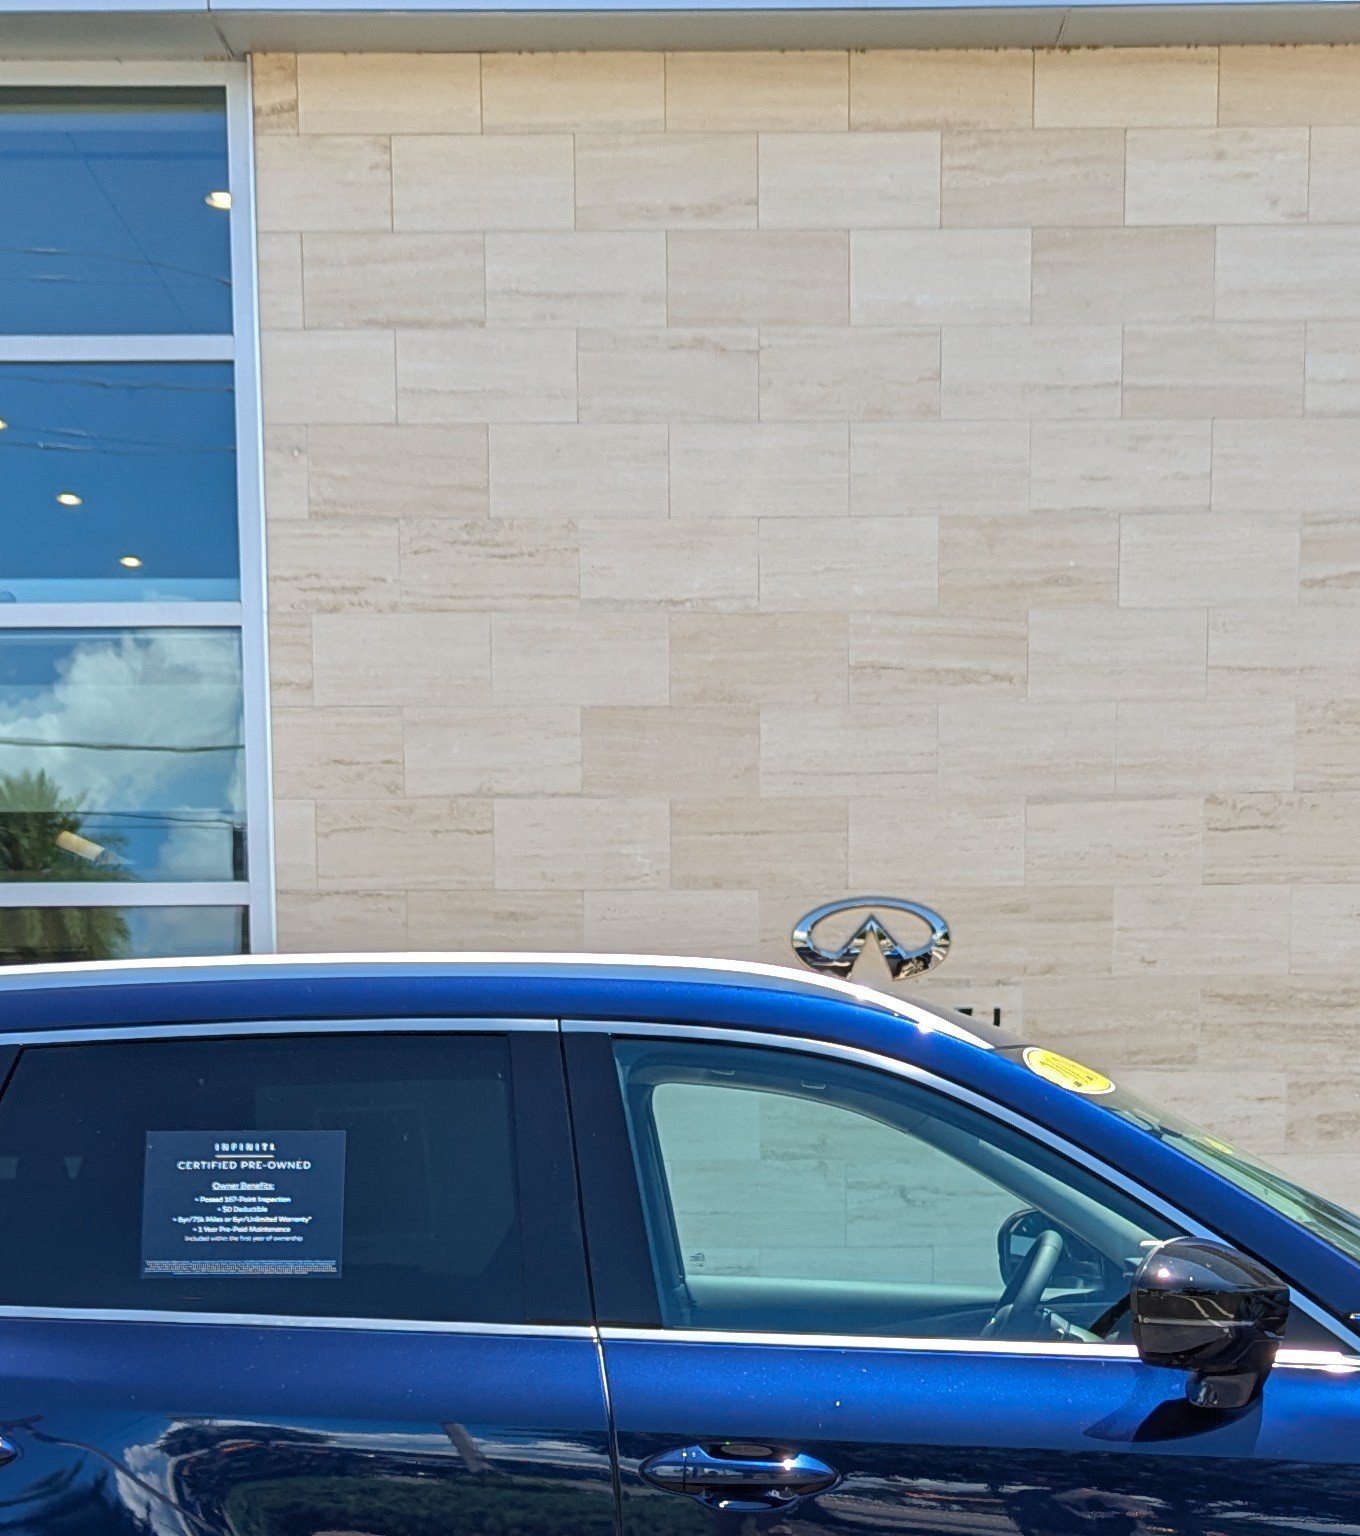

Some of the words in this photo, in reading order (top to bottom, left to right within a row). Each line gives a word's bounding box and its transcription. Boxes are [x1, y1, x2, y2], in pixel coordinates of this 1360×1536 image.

[214, 1142, 276, 1151] INFINITI
[176, 1160, 238, 1170] CERTIFIED
[240, 1160, 312, 1170] PRE-OWNED
[211, 1181, 239, 1191] Owner
[258, 1195, 291, 1204] Inspection
[233, 1205, 268, 1213] Deductible
[218, 1225, 248, 1233] Pre-Paid
[273, 1235, 304, 1243] ownership
